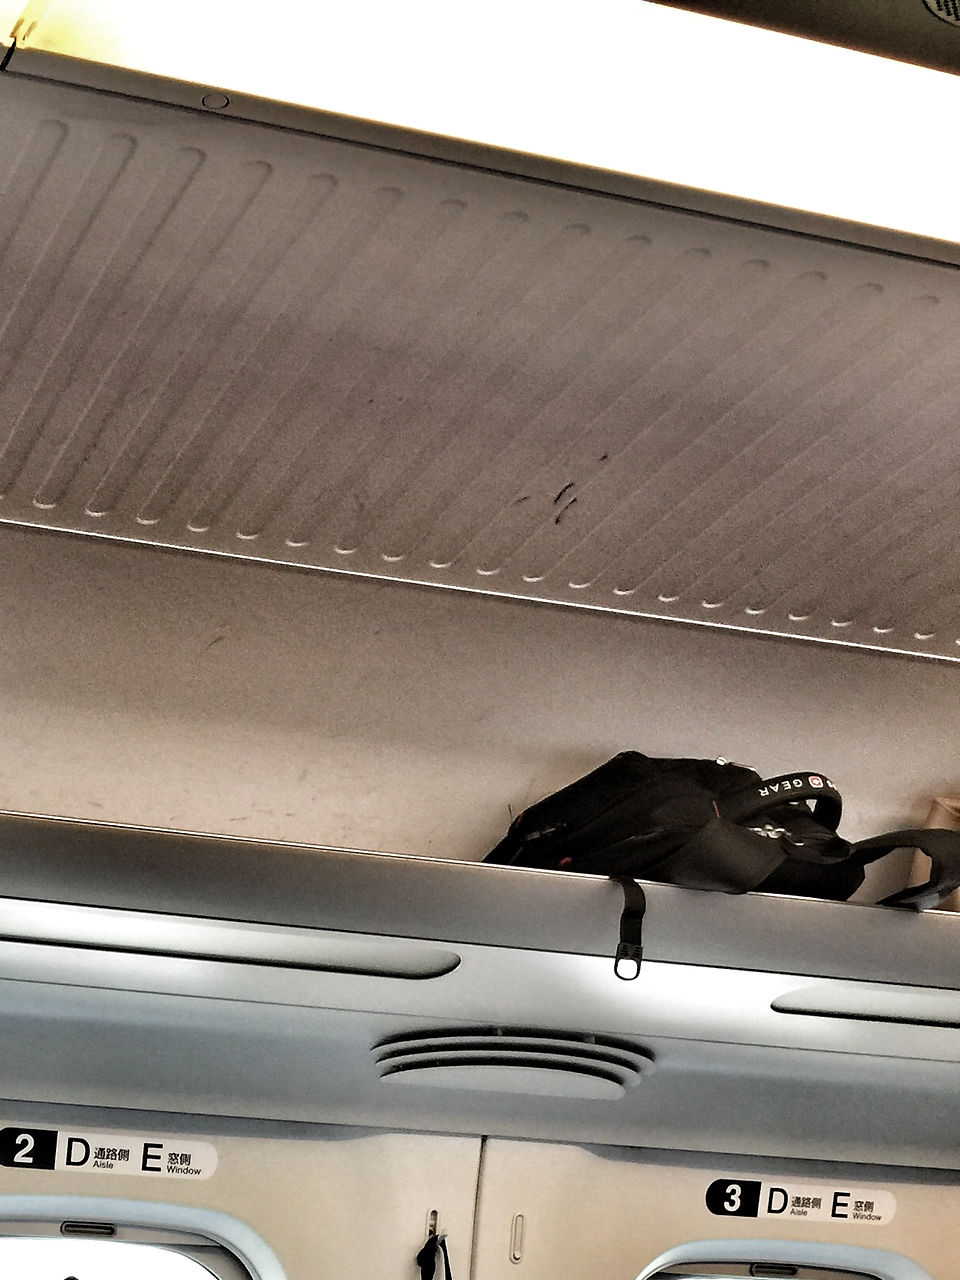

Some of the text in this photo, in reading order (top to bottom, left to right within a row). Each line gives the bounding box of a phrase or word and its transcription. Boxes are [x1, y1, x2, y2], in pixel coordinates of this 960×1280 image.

[758, 779, 803, 797] GEAR
[13, 1133, 192, 1172] 2 D 通路側 E 窓側
[93, 1160, 202, 1176] Aisle Window
[723, 1184, 742, 1212] 3
[767, 1187, 789, 1214] D
[791, 1196, 823, 1210] 通路側
[831, 1191, 851, 1219] E
[790, 1208, 883, 1221] Aisle Window
